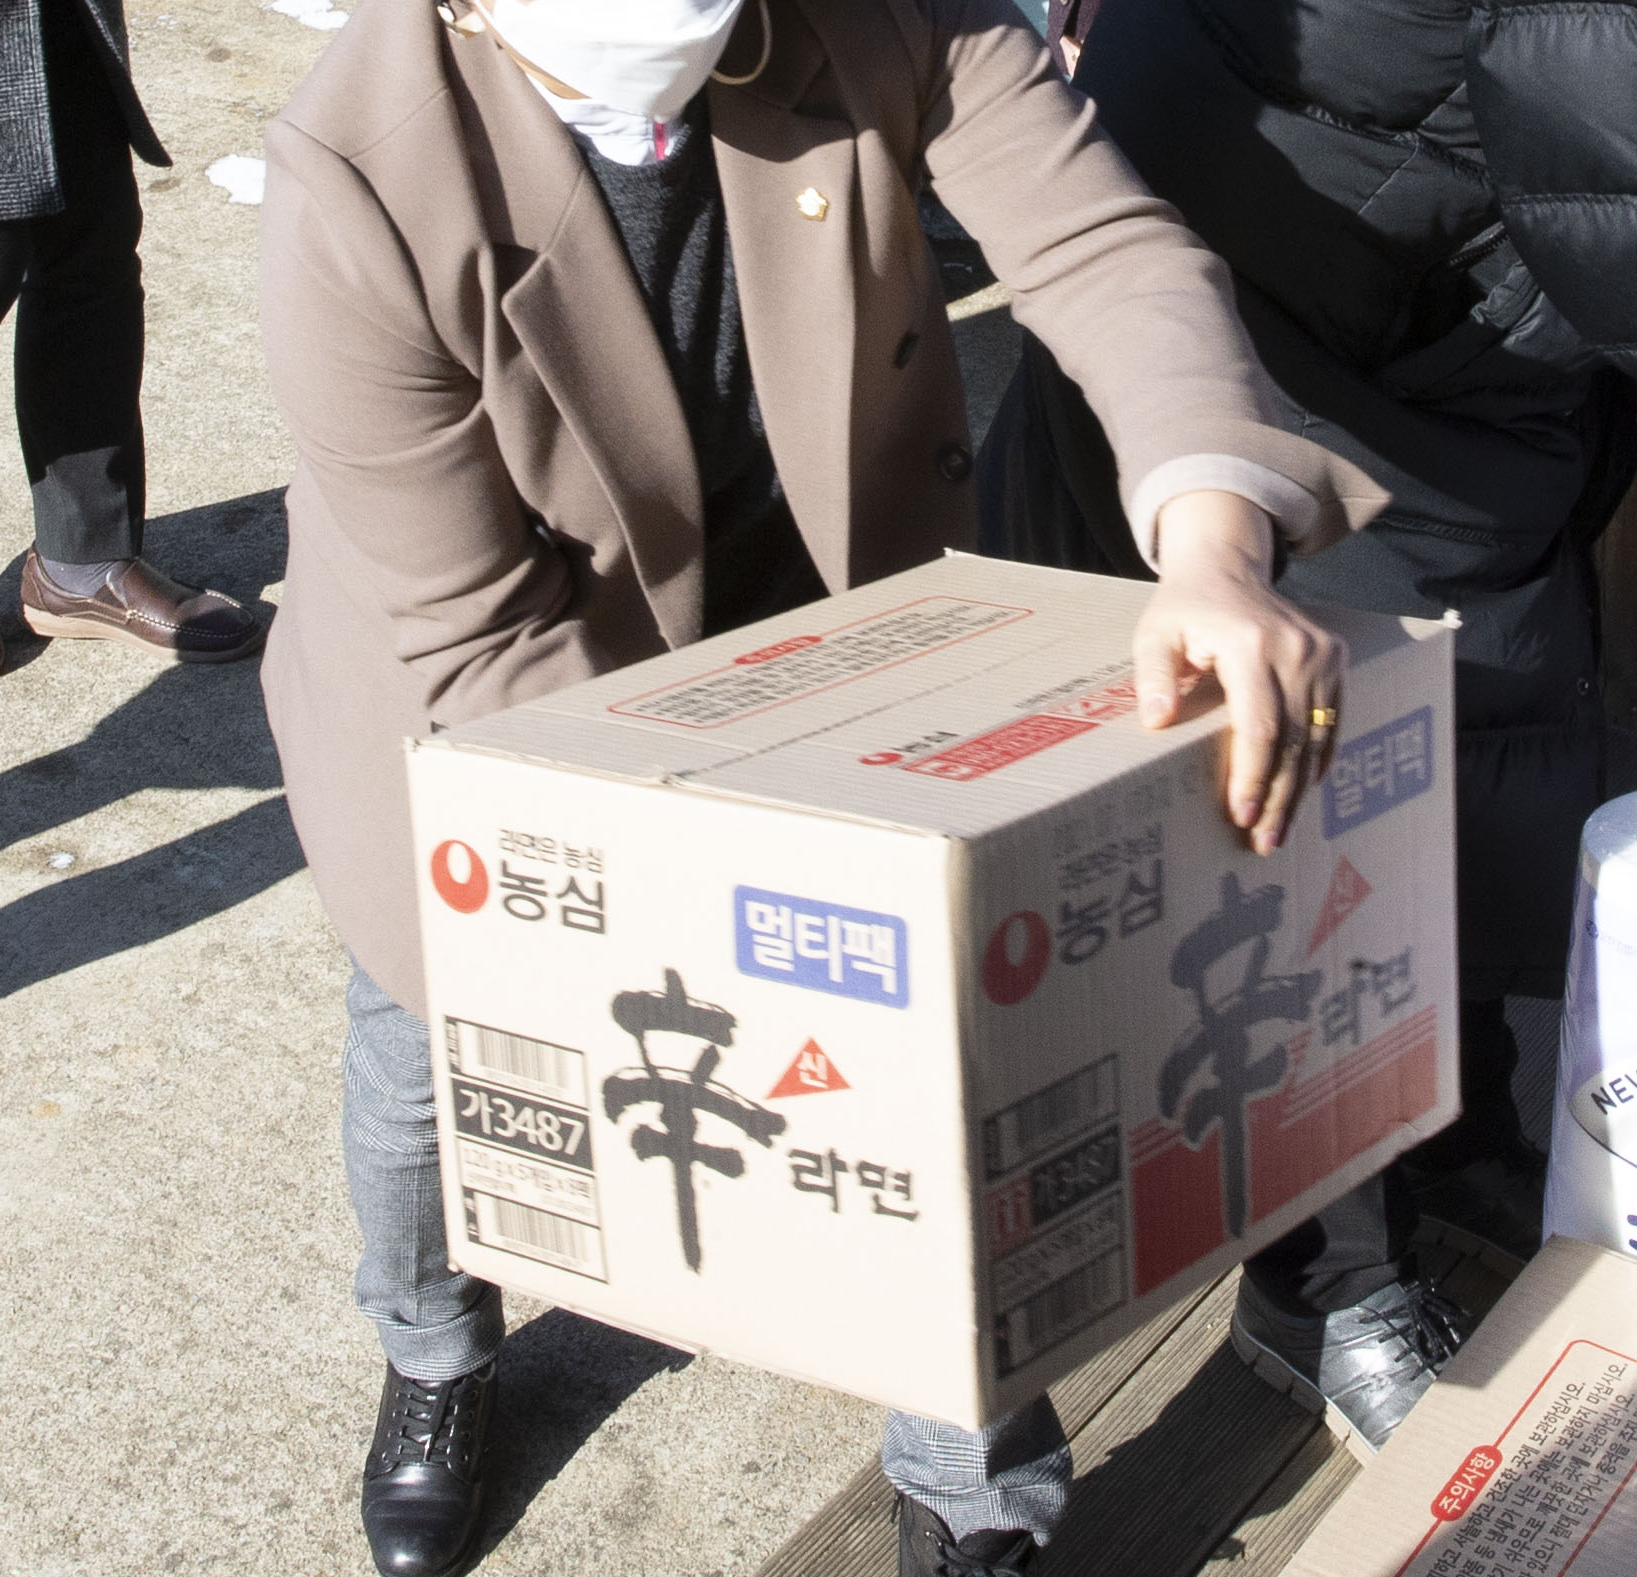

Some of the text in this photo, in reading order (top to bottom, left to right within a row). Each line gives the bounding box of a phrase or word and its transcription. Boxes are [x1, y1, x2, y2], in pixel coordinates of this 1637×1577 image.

[1332, 720, 1427, 821] 멀티팩
[498, 829, 603, 874] 라면은 농심
[499, 860, 605, 935] 농심
[745, 899, 898, 996] 멀티팩
[1059, 859, 1163, 965] 농심
[797, 1051, 829, 1089] 신
[1157, 870, 1324, 1241] 辛
[459, 1087, 585, 1156] 가3487
[602, 967, 788, 1275] 辛
[788, 1146, 920, 1223] 라면
[1439, 1452, 1494, 1518] 주의사항
[1454, 1502, 1495, 1551] 서늘하고
[1487, 1468, 1520, 1506] 건조한
[1513, 1445, 1537, 1472] 곳에
[1530, 1378, 1585, 1448] 보관하십시오.
[1475, 1545, 1494, 1563] 등
[1486, 1509, 1521, 1548] 냄새가
[1513, 1484, 1539, 1512] 나는
[1532, 1450, 1563, 1487] 곳에는
[1556, 1405, 1596, 1453] 보관하지
[1588, 1360, 1629, 1409] 마십시오.
[1539, 1482, 1571, 1519] 깨끗한
[1563, 1457, 1588, 1484] 곳에
[1581, 1391, 1636, 1460] 보관하십시오.
[1527, 1539, 1561, 1576] 있으니
[1551, 1514, 1578, 1543] 절대
[1569, 1474, 1605, 1517] 던지거나
[1597, 1443, 1628, 1478] 충격을
